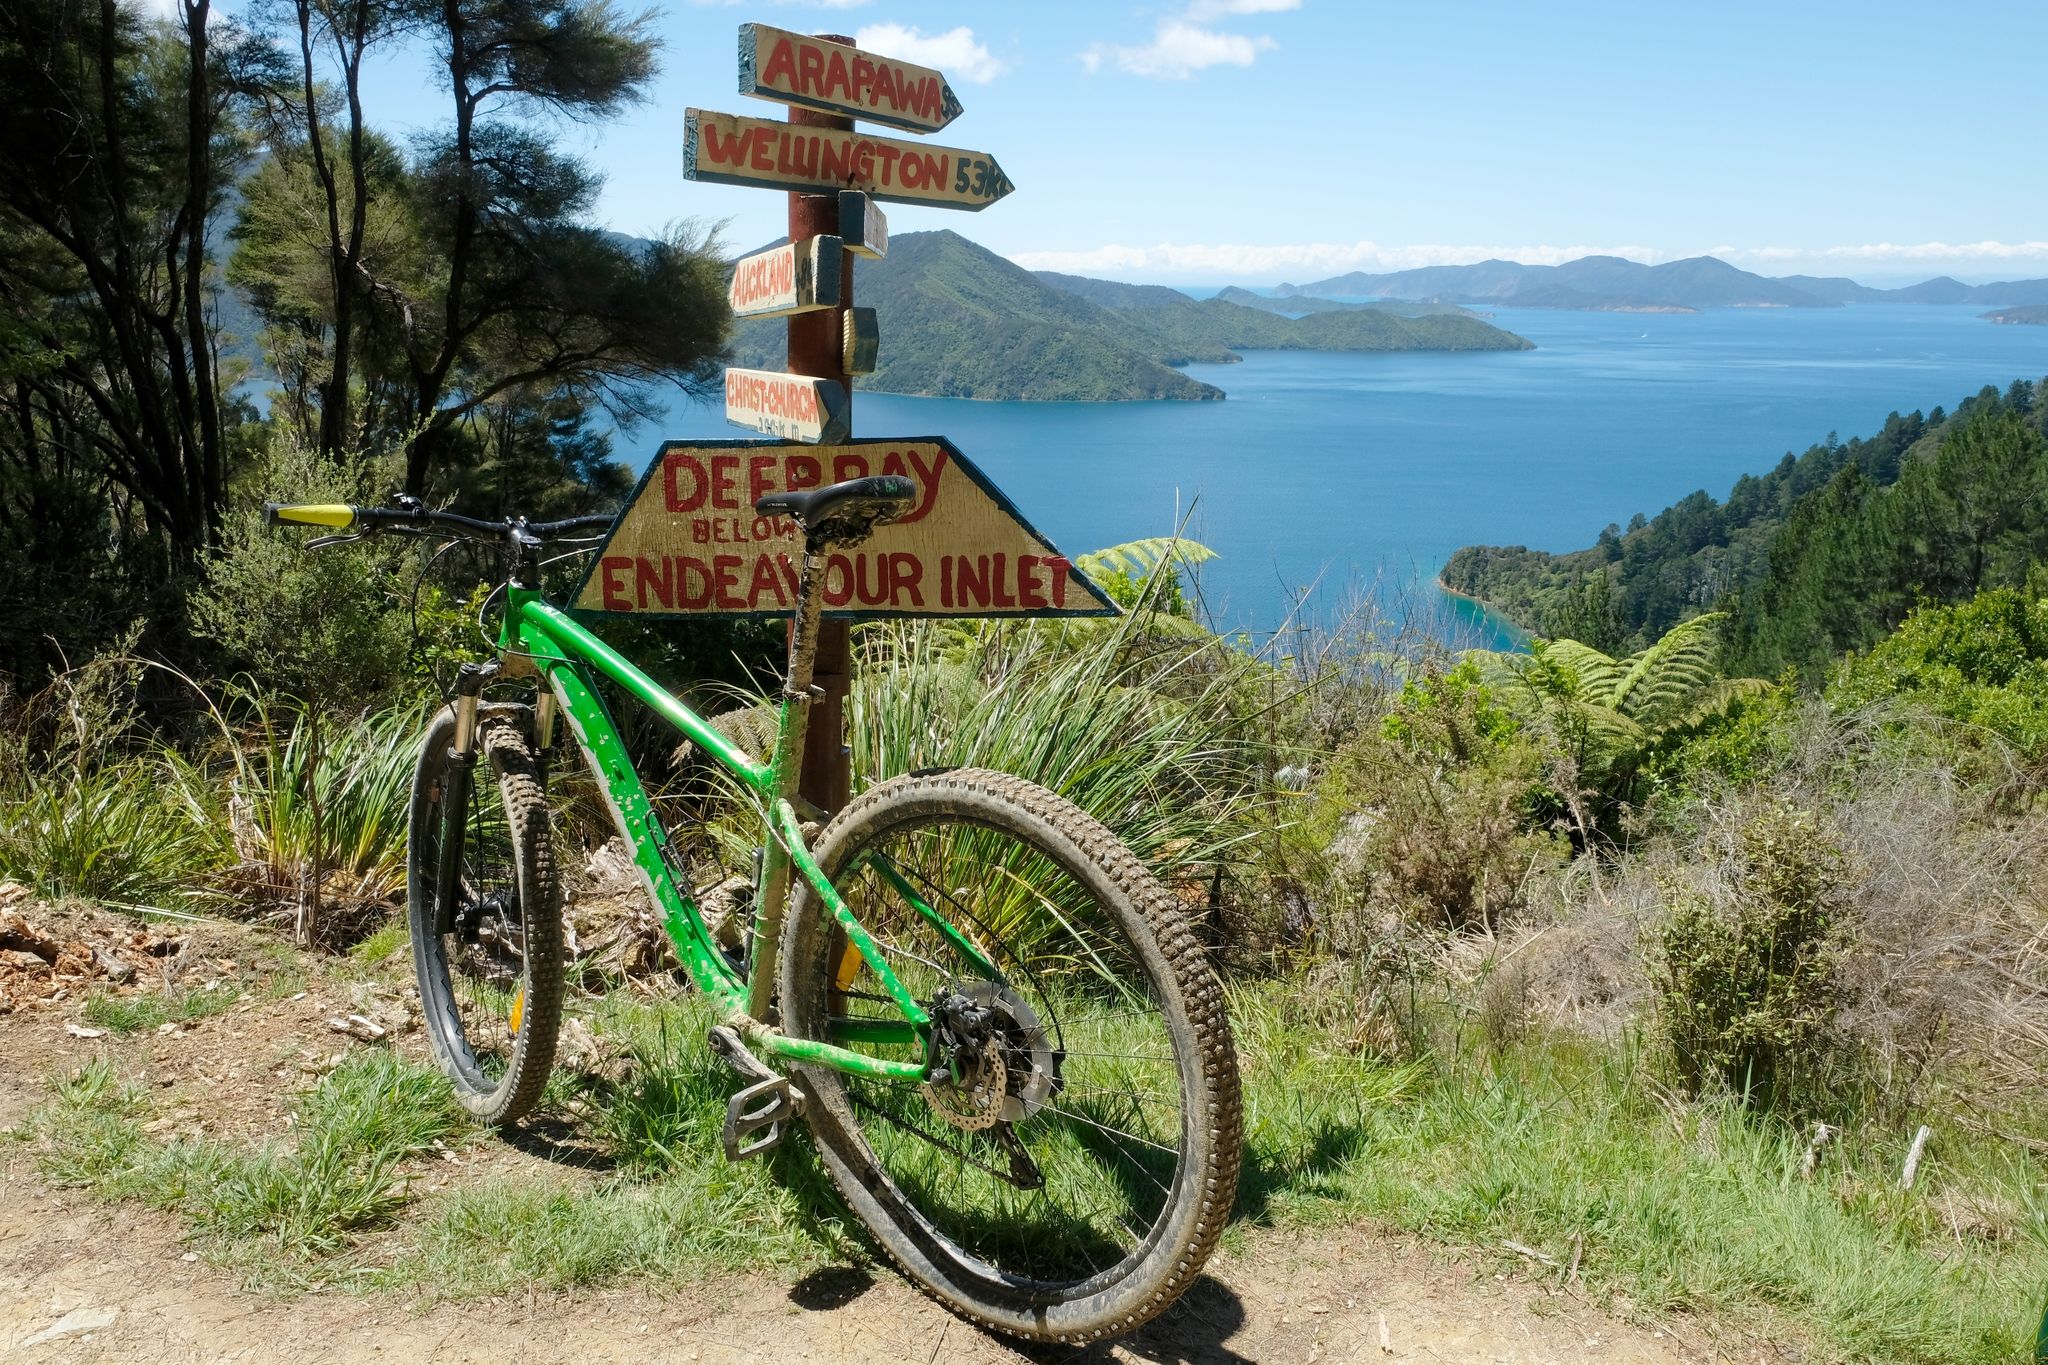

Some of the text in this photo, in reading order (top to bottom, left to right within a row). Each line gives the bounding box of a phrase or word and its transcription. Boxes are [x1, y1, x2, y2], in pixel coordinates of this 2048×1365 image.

[762, 38, 941, 123] ARAPAWA
[704, 124, 949, 192] WELLINGTON
[733, 251, 793, 308] AUCKLAND
[662, 454, 822, 513] DEEP
[692, 515, 798, 544] BELOW
[600, 551, 1073, 611] ENDEAVOUR INLET
